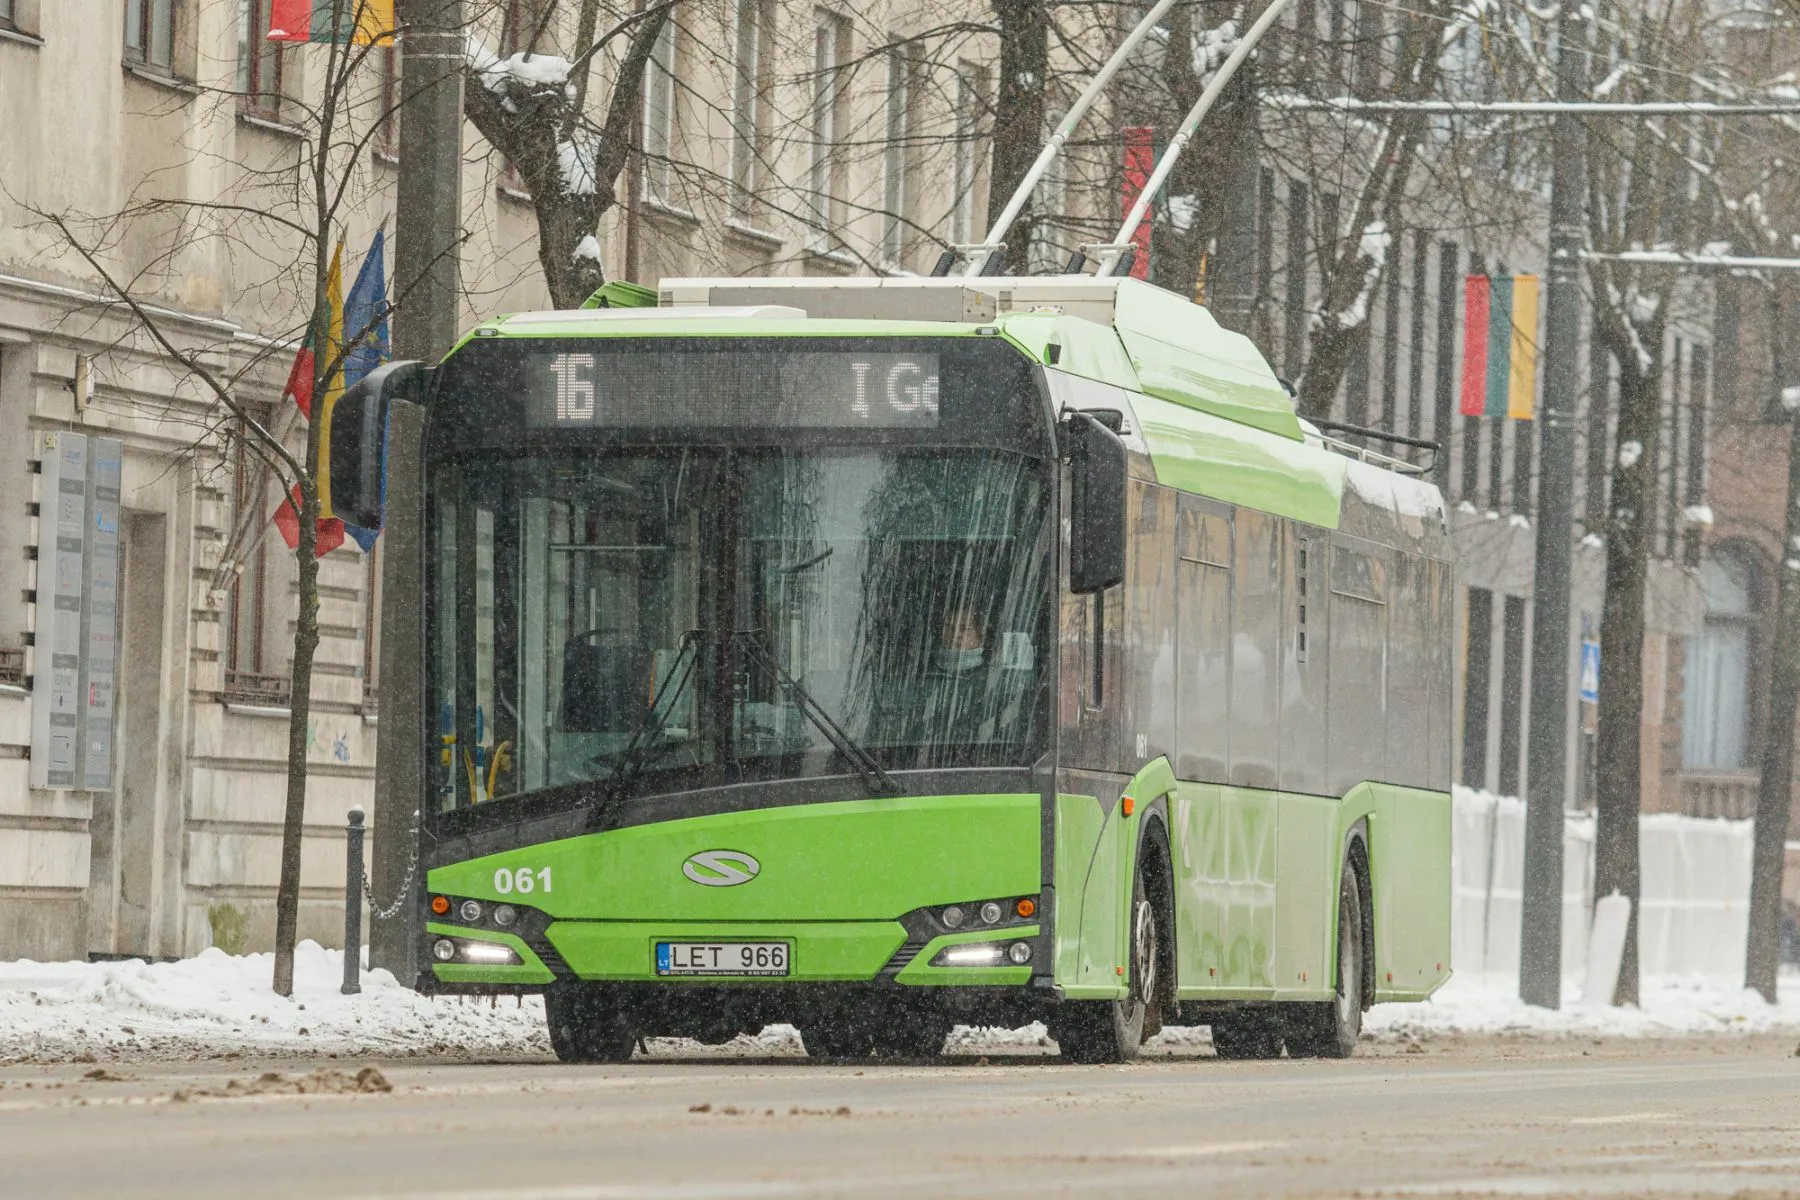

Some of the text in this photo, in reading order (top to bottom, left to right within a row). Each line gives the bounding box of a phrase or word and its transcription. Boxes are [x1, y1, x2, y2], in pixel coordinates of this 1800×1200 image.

[550, 354, 593, 419] 16
[494, 867, 552, 894] 061
[672, 947, 784, 967] LET 966
